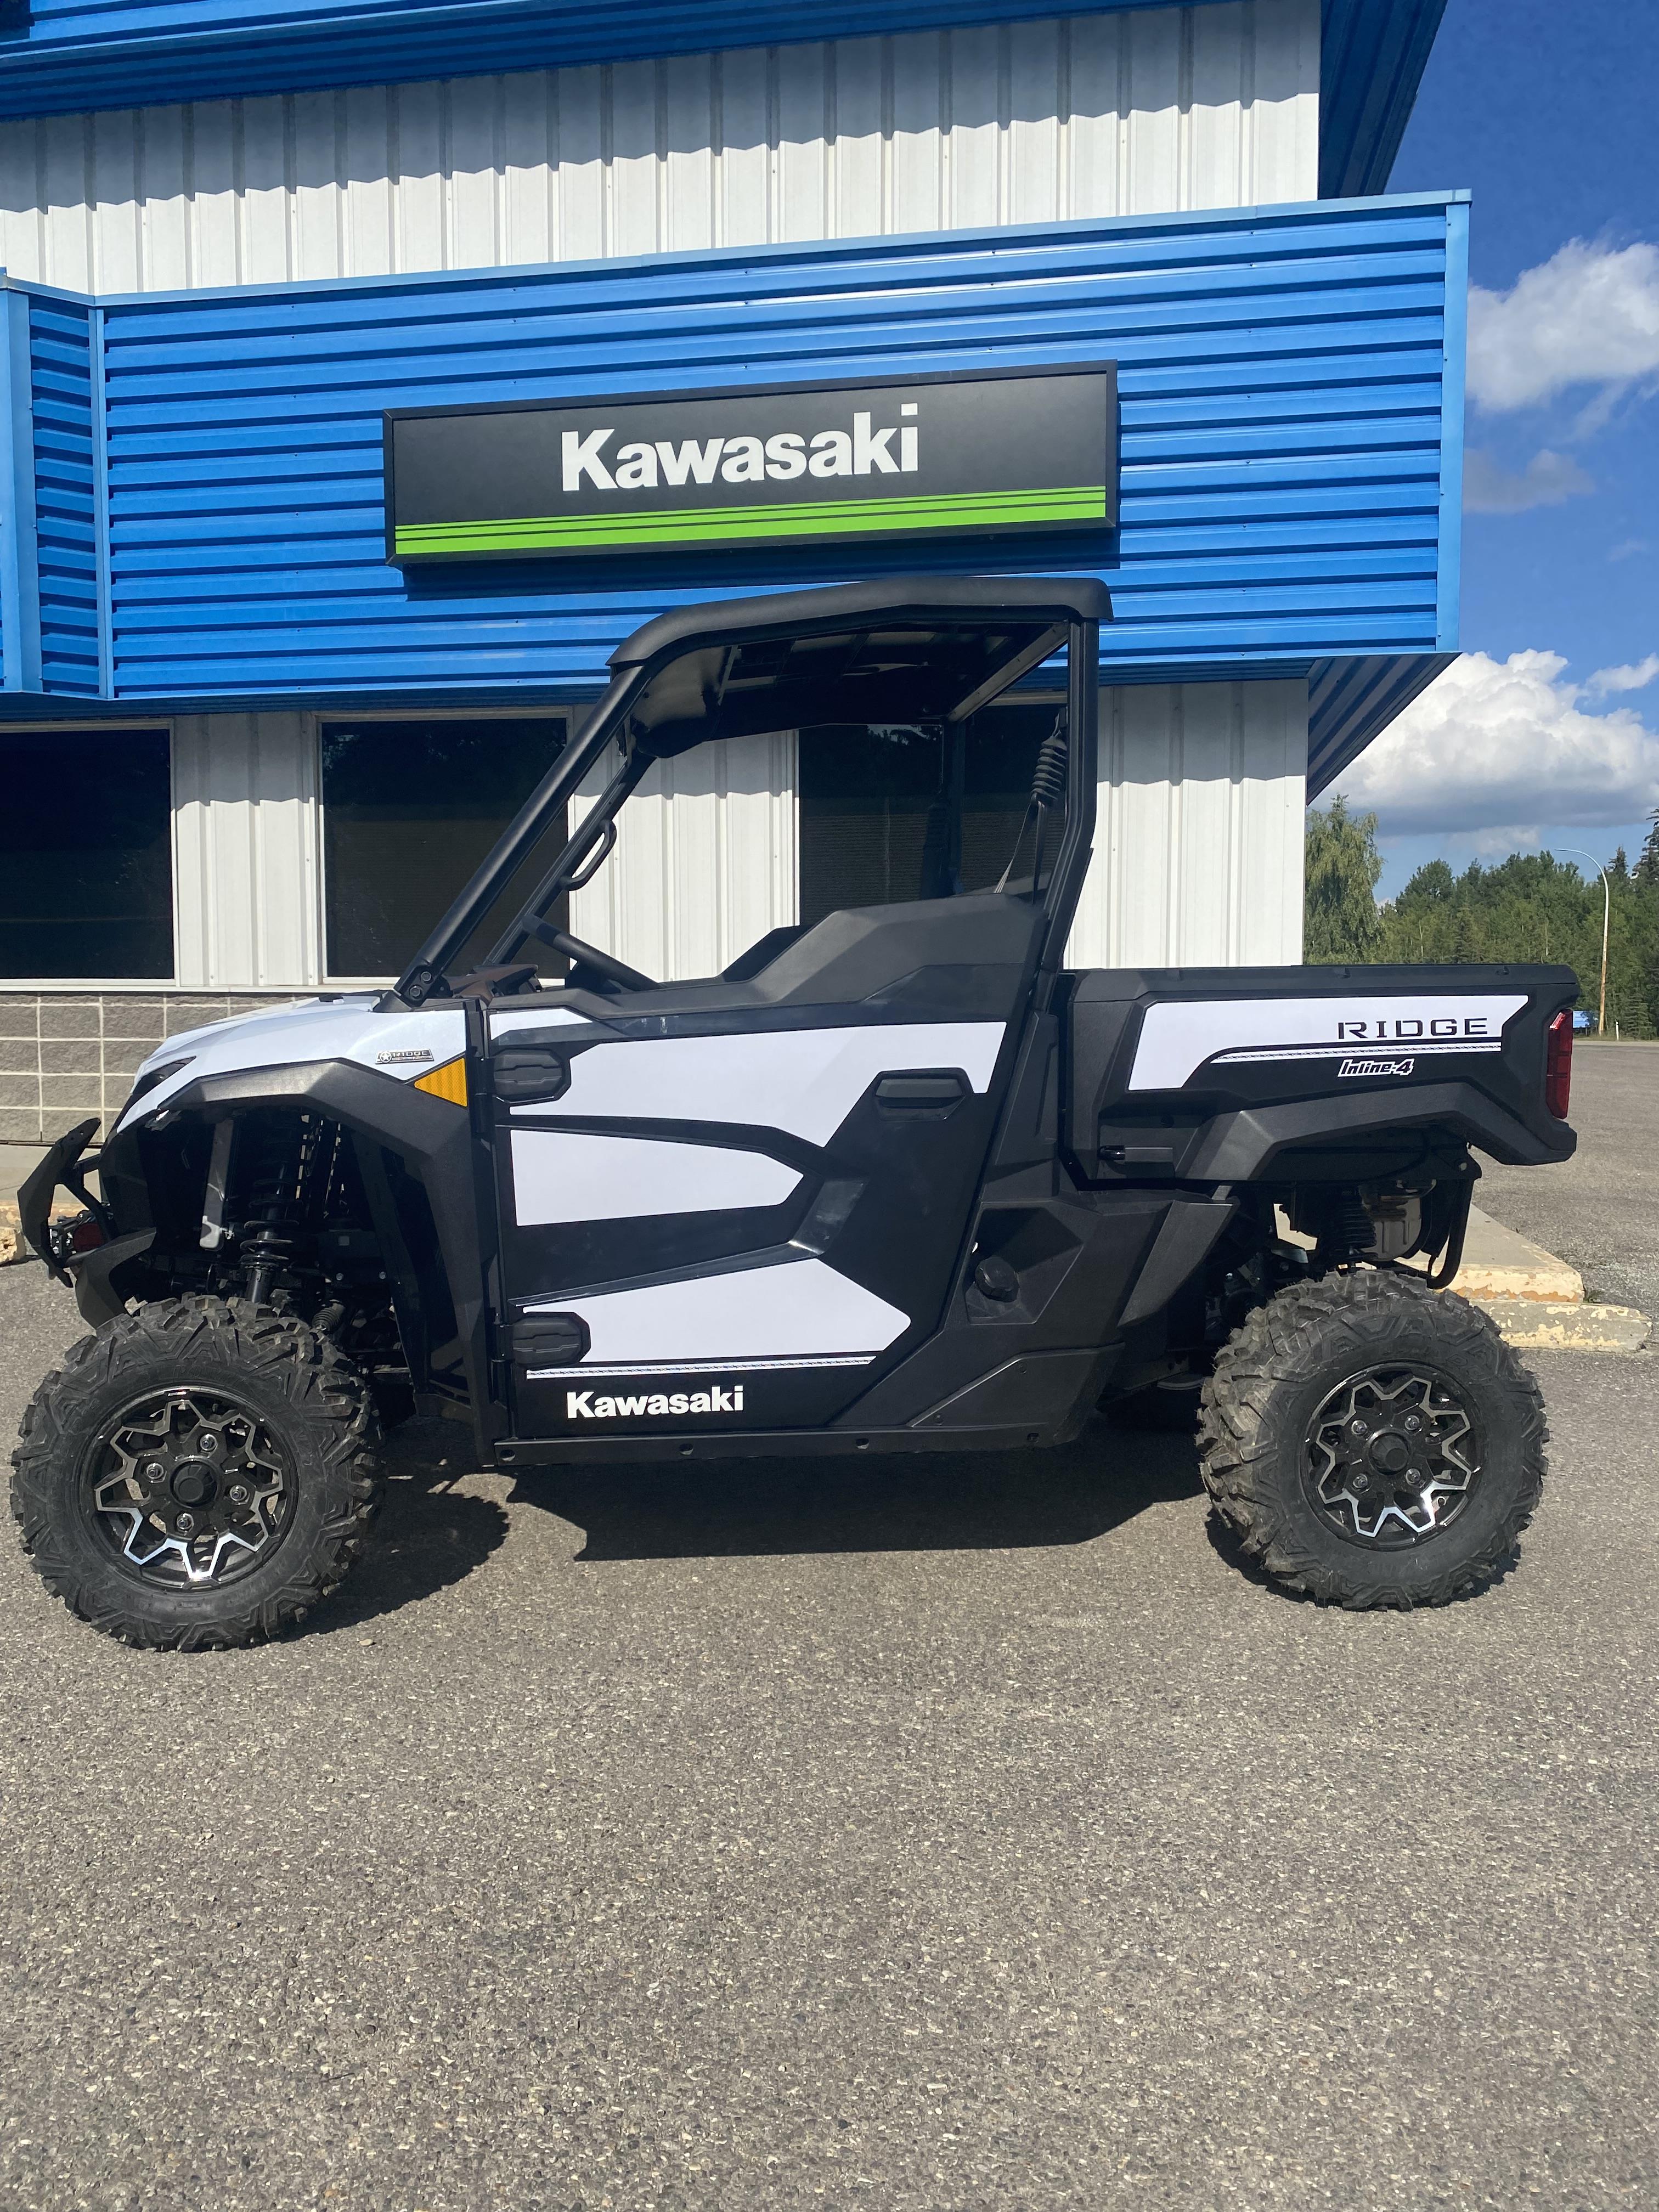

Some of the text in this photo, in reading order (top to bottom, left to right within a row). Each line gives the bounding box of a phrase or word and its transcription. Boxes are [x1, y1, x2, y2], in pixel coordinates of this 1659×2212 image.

[562, 403, 919, 492] Kawasaki
[1338, 1018, 1488, 1039] RIDGE
[1338, 1059, 1414, 1077] Inline-4
[567, 1385, 743, 1419] Kawasaki
